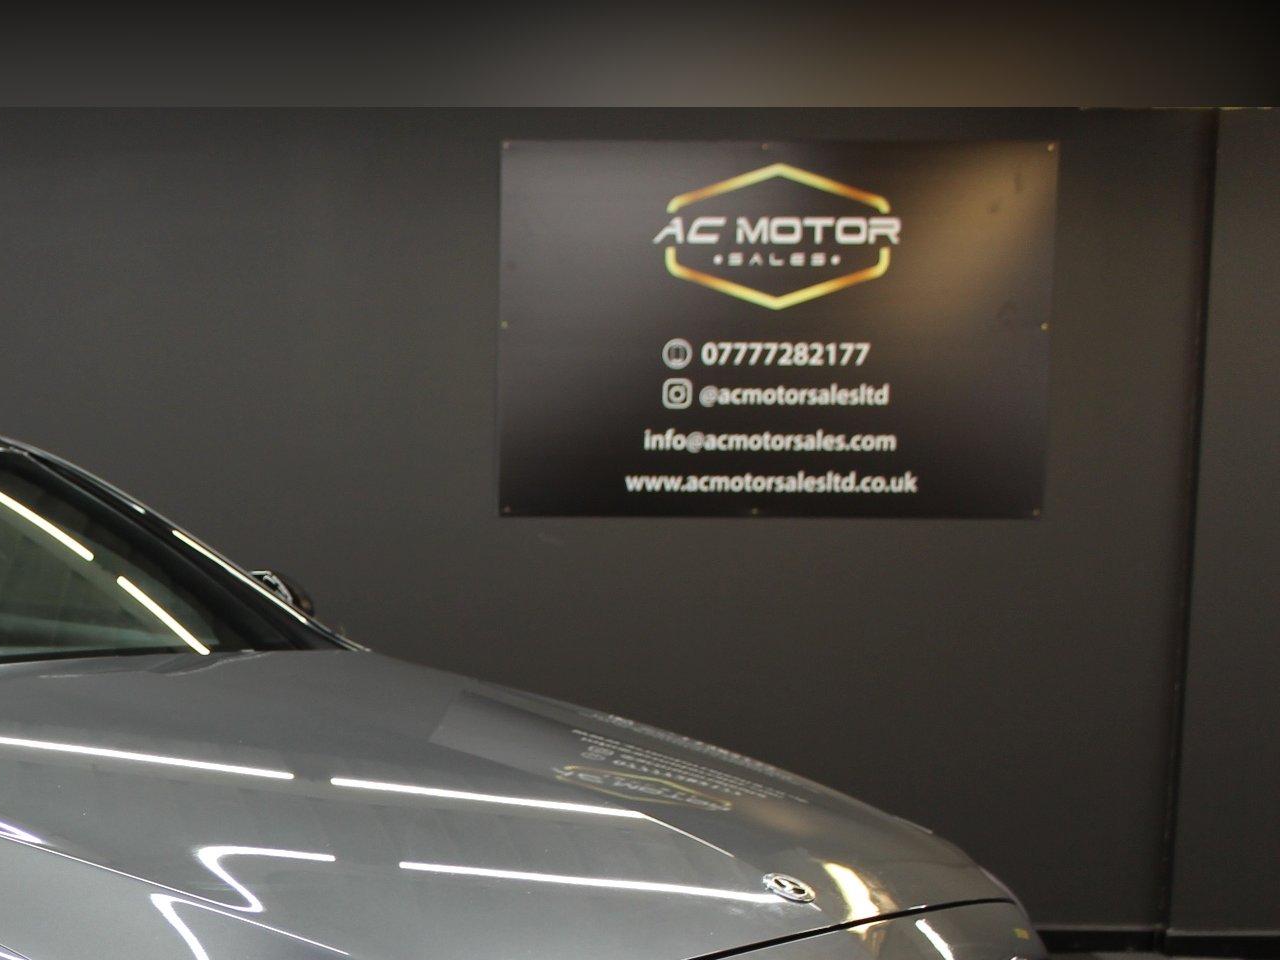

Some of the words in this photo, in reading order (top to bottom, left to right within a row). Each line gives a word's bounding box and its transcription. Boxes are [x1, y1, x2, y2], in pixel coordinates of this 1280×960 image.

[652, 216, 727, 245] AC
[735, 216, 902, 245] MOTOR
[727, 252, 827, 267] SALES
[700, 341, 871, 367] 07777282177
[699, 382, 890, 408] @acmotorsalesltd
[643, 428, 897, 454] info@acmotorsales.com
[625, 470, 918, 493] www.acmotorsalesltd.co.uk
